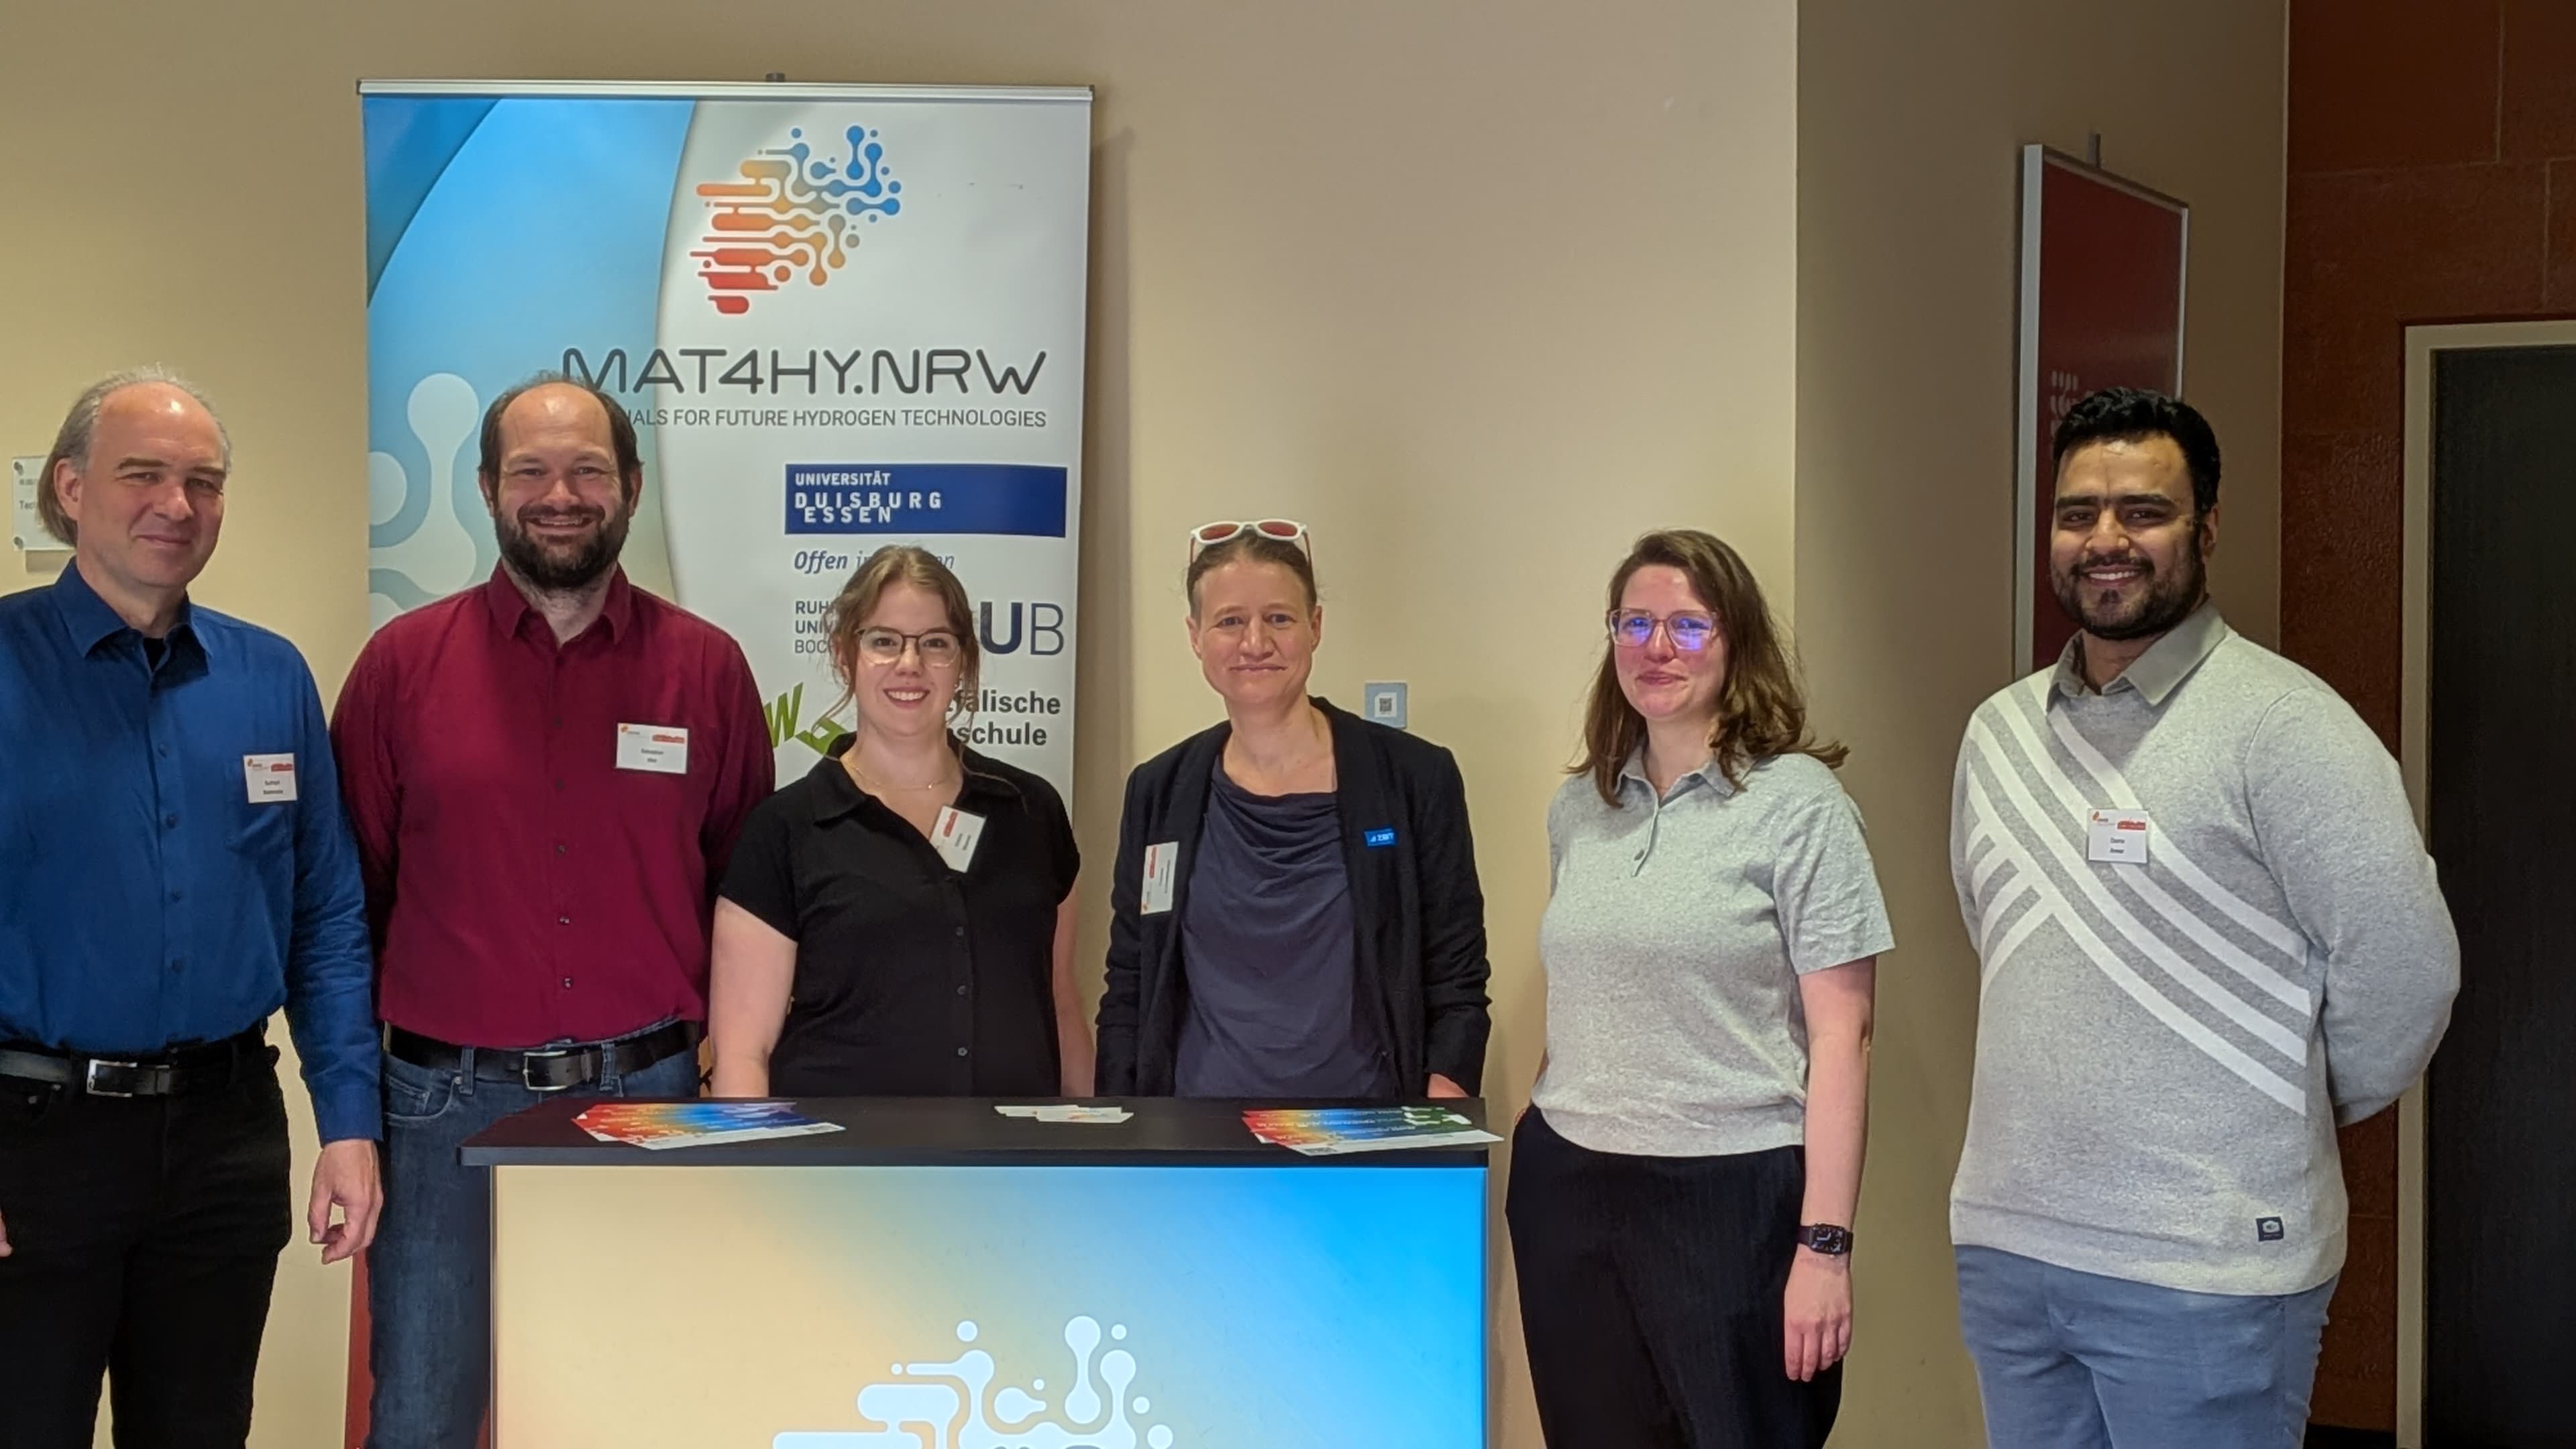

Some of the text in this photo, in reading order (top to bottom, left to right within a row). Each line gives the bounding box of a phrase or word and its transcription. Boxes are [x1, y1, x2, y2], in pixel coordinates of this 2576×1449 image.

[562, 347, 1047, 395] MAT4HY.NRW
[674, 409, 711, 426] FOR
[715, 410, 788, 427] FUTURE
[793, 410, 896, 427] HYDROGEN
[901, 410, 1047, 428] TECHNOLOGIES
[795, 470, 892, 486] UNIVERSITÄT
[795, 492, 942, 509] DUISBURG
[804, 506, 892, 523] ESSEN
[794, 551, 848, 574] Offen
[795, 600, 830, 614] RUH
[979, 602, 1064, 655] UB
[794, 639, 828, 654] BOC
[947, 721, 1047, 746] schule
